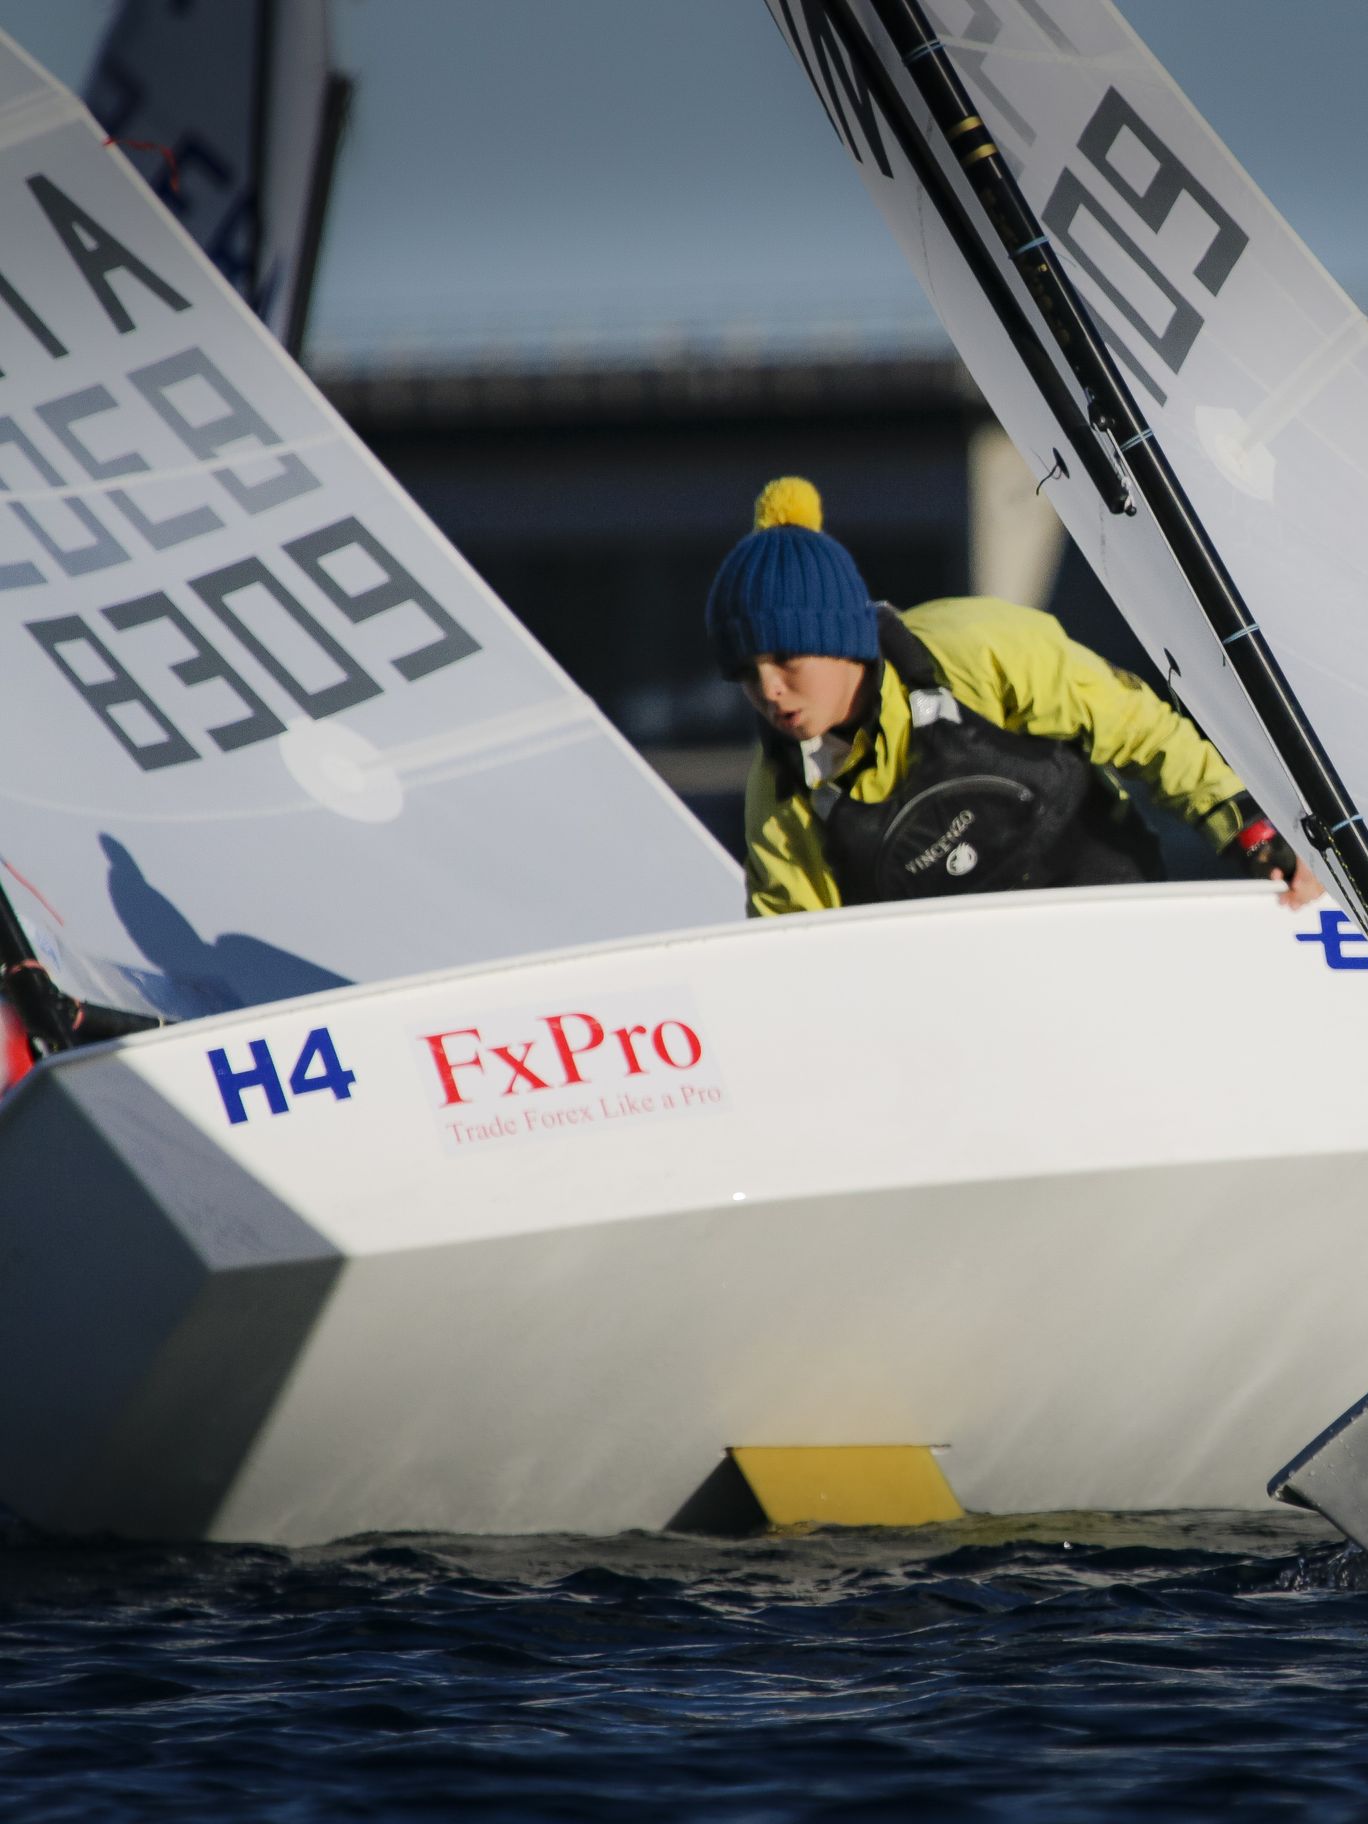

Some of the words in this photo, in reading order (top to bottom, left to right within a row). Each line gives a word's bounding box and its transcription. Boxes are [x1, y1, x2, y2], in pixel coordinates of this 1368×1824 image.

[24, 516, 483, 772] 8309
[904, 809, 976, 874] VINCENZO
[207, 1027, 356, 1124] H4
[418, 1011, 704, 1108] FxPro
[447, 1113, 518, 1146] Trade
[523, 1104, 595, 1131] Forex
[599, 1092, 654, 1120] Like
[662, 1094, 677, 1109] a
[680, 1083, 722, 1107] Pro
